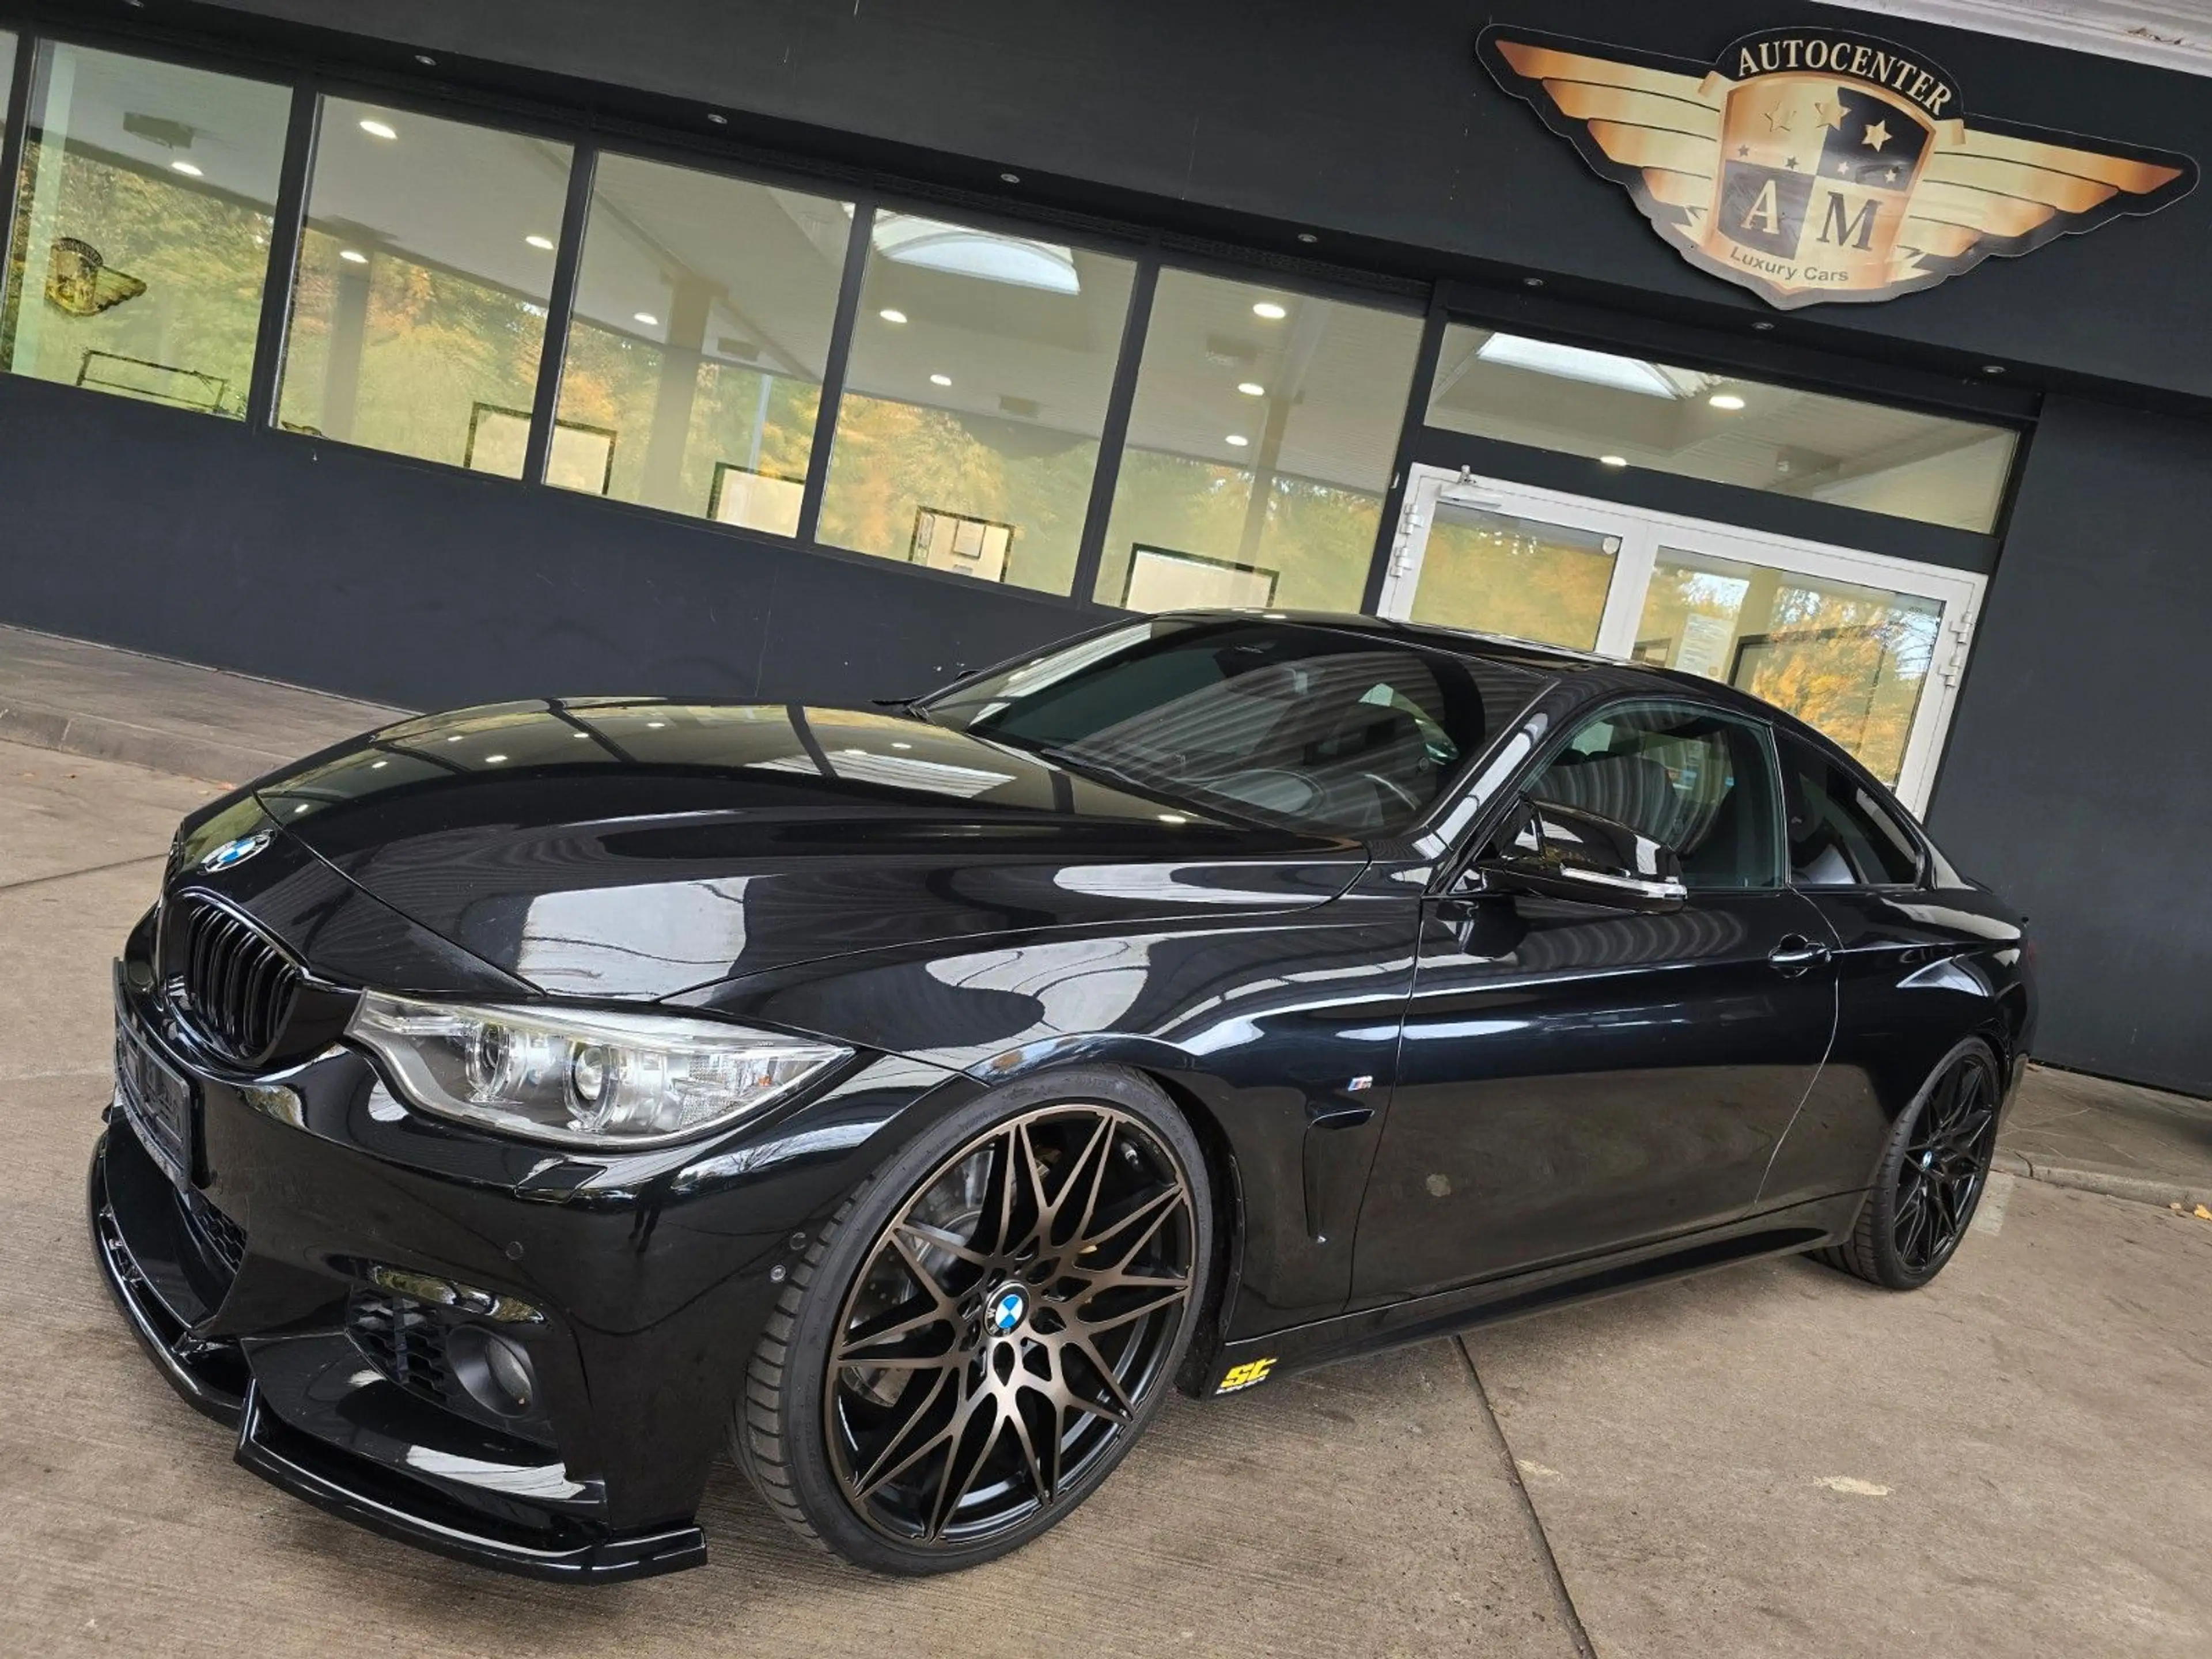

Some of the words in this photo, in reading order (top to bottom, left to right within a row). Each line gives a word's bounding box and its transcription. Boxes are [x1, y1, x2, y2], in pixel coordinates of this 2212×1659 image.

[1738, 40, 1952, 115] AUTOCENTER
[1740, 179, 1780, 234] A
[1816, 191, 1884, 251] M
[1730, 246, 1798, 281] Luxury
[1804, 266, 1849, 281] Cars
